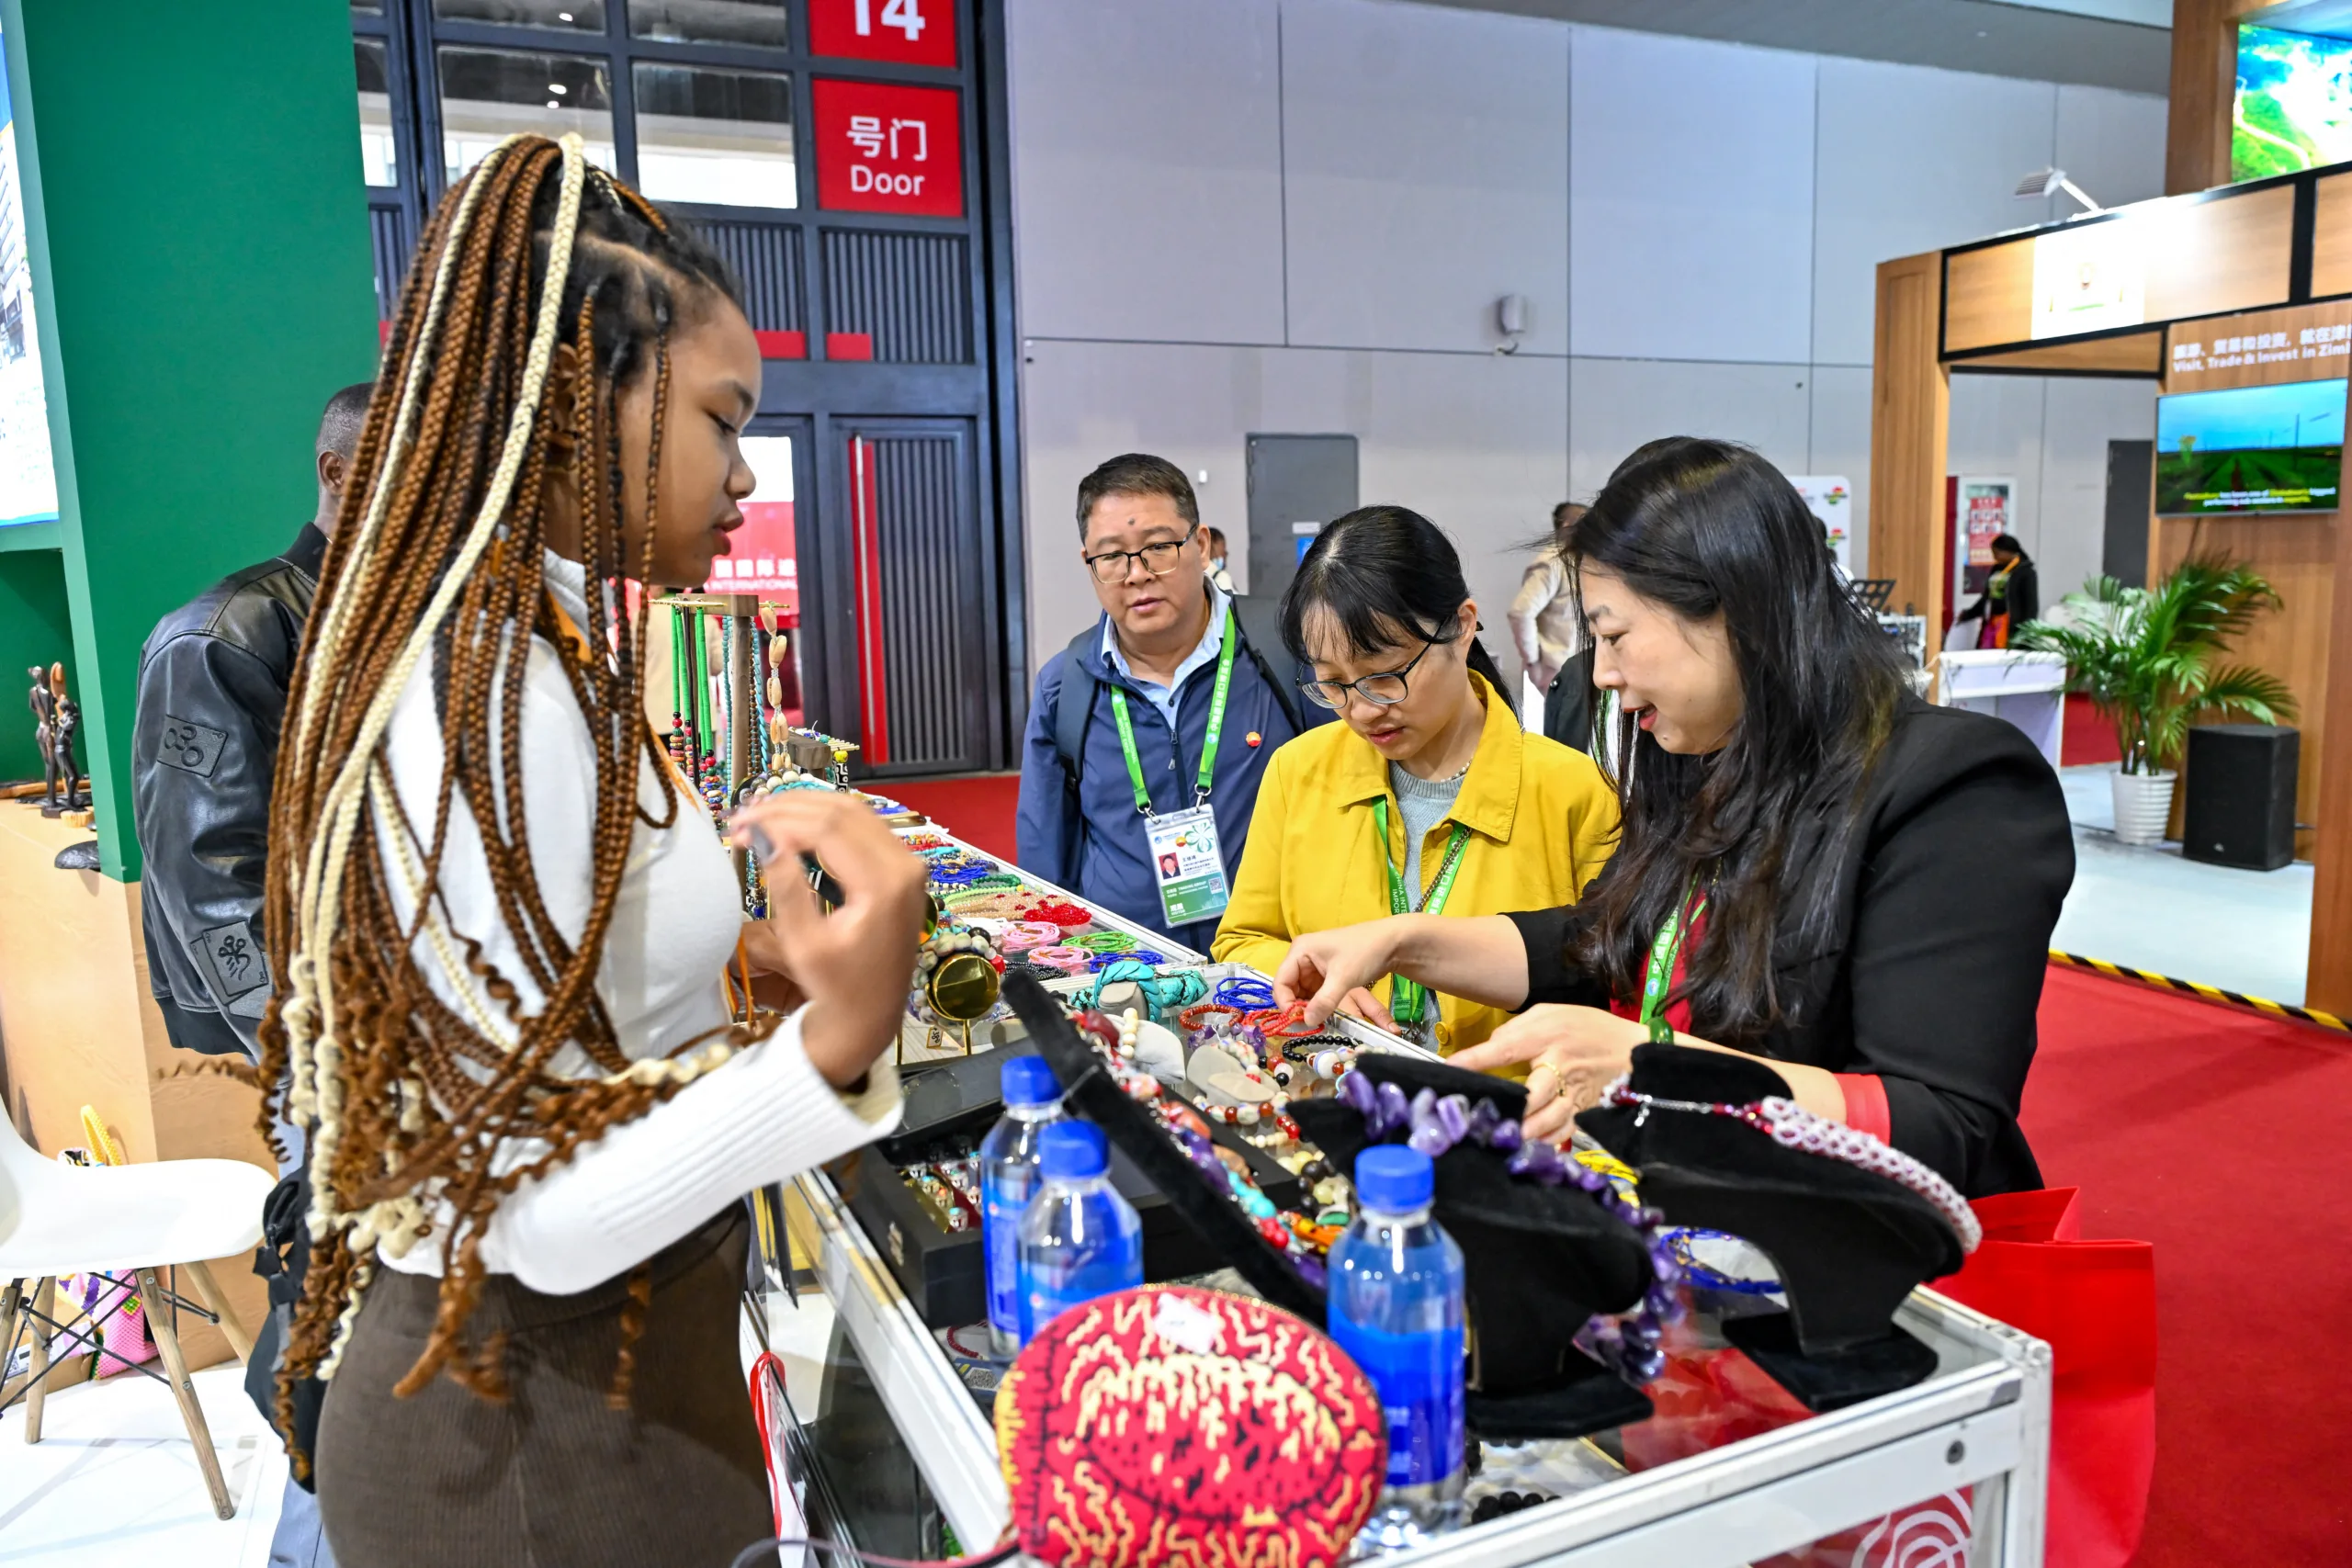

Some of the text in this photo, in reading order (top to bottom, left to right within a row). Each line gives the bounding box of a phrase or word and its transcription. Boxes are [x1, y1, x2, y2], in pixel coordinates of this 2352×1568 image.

[854, 0, 925, 41] 14
[846, 116, 928, 162] 号门
[851, 164, 925, 196] Door
[2208, 355, 2243, 368] Trade
[2257, 349, 2298, 364] Invest
[2302, 346, 2315, 358] in
[1395, 872, 1405, 896] CHINA
[1392, 888, 1400, 914] IMPOR
